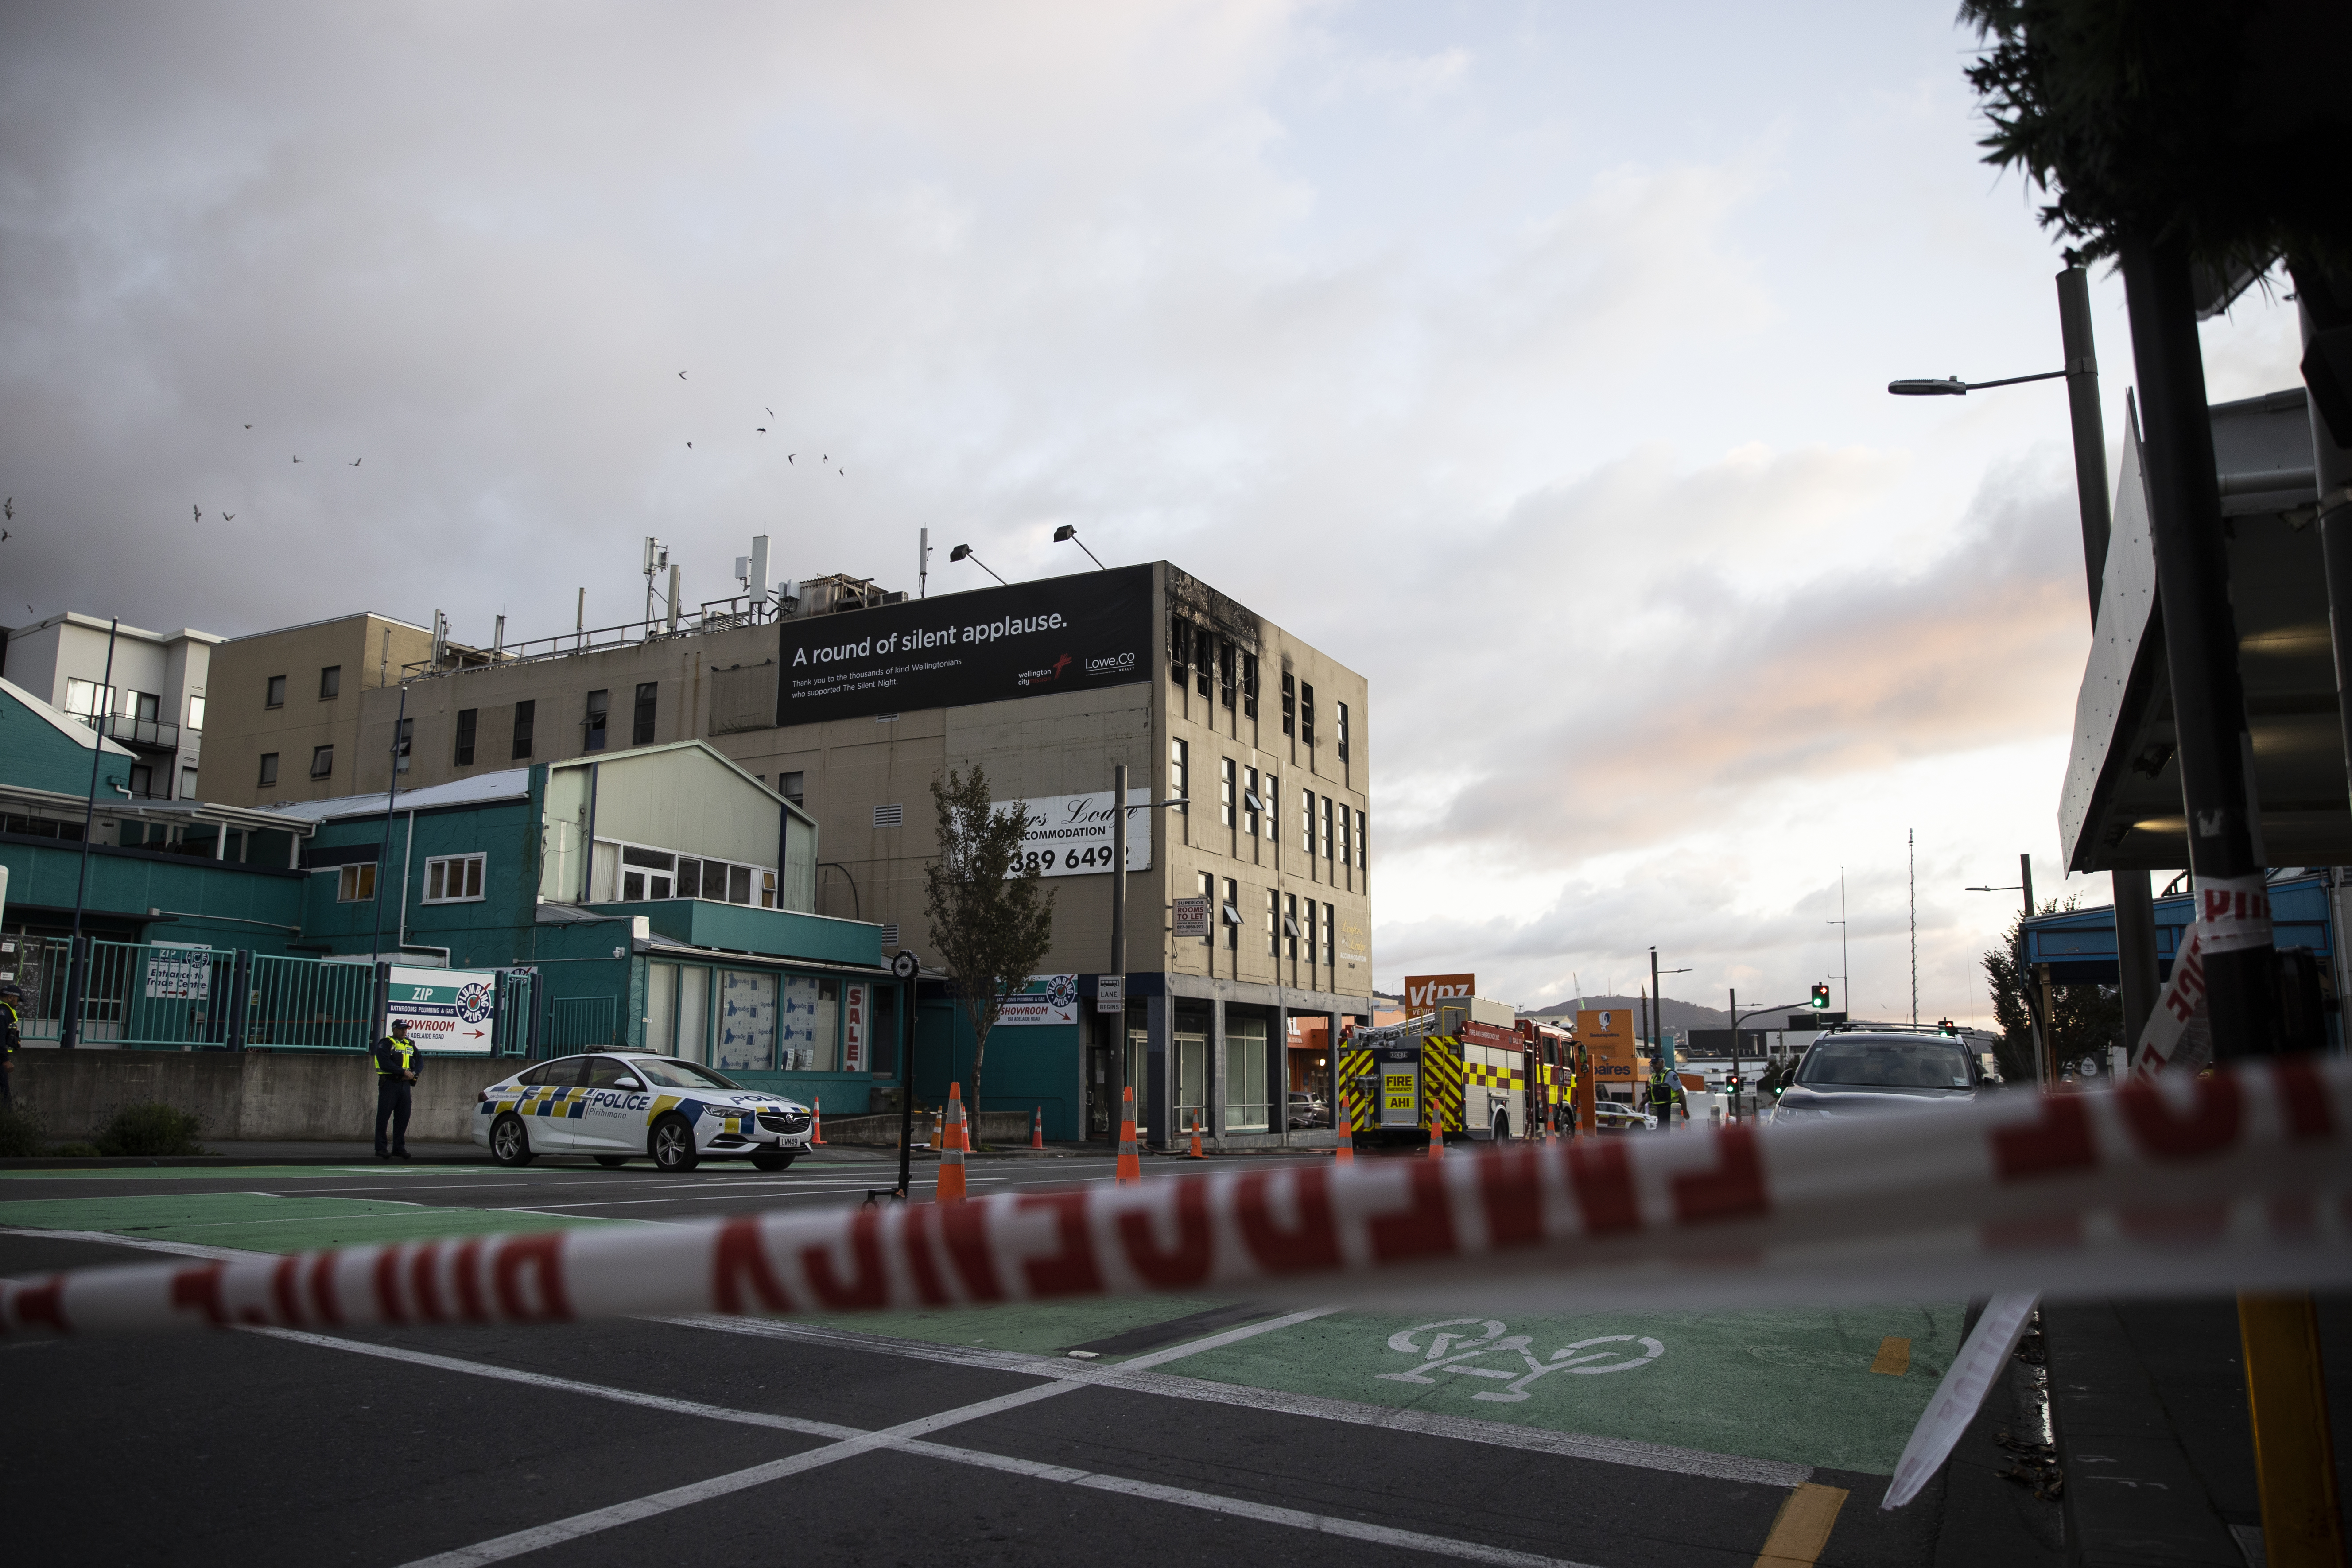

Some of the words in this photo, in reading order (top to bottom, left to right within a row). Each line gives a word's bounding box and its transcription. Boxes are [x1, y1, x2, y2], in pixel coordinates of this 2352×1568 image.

[792, 648, 807, 666] A
[813, 637, 870, 664] round
[876, 633, 897, 654] of
[902, 625, 957, 651] silent
[962, 613, 1067, 644] applause.
[792, 679, 811, 687] Thank
[814, 677, 826, 686] you
[849, 668, 884, 679] thousands
[895, 665, 909, 673] kind
[912, 659, 962, 671] Wellingtonians
[1018, 669, 1051, 679] wellington
[807, 686, 841, 697] supported
[857, 681, 876, 690] Silent
[878, 679, 898, 687] Night.
[1019, 826, 1106, 841] COMMODATION
[1010, 850, 1056, 873] 389
[1065, 846, 1129, 869] 649
[160, 949, 177, 958] ZIP
[151, 968, 192, 979] Entrance
[147, 978, 174, 987] Trade
[179, 979, 207, 989] Centre
[1048, 977, 1074, 994] PLUMBING
[411, 987, 433, 1001] ZIP
[458, 984, 489, 1008] PLUMBING
[1053, 997, 1069, 1006] PLUS
[463, 1009, 482, 1022] PLUS
[1000, 1006, 1048, 1015] SHOWROOM
[405, 1019, 455, 1032] OWROOM
[847, 989, 861, 1061] SALE
[1386, 1076, 1412, 1087] FIRE
[592, 1092, 651, 1111] POLICE
[1390, 1098, 1409, 1107] AHI
[589, 1107, 627, 1119] Pirihimana
[781, 1138, 798, 1146] LWM49
